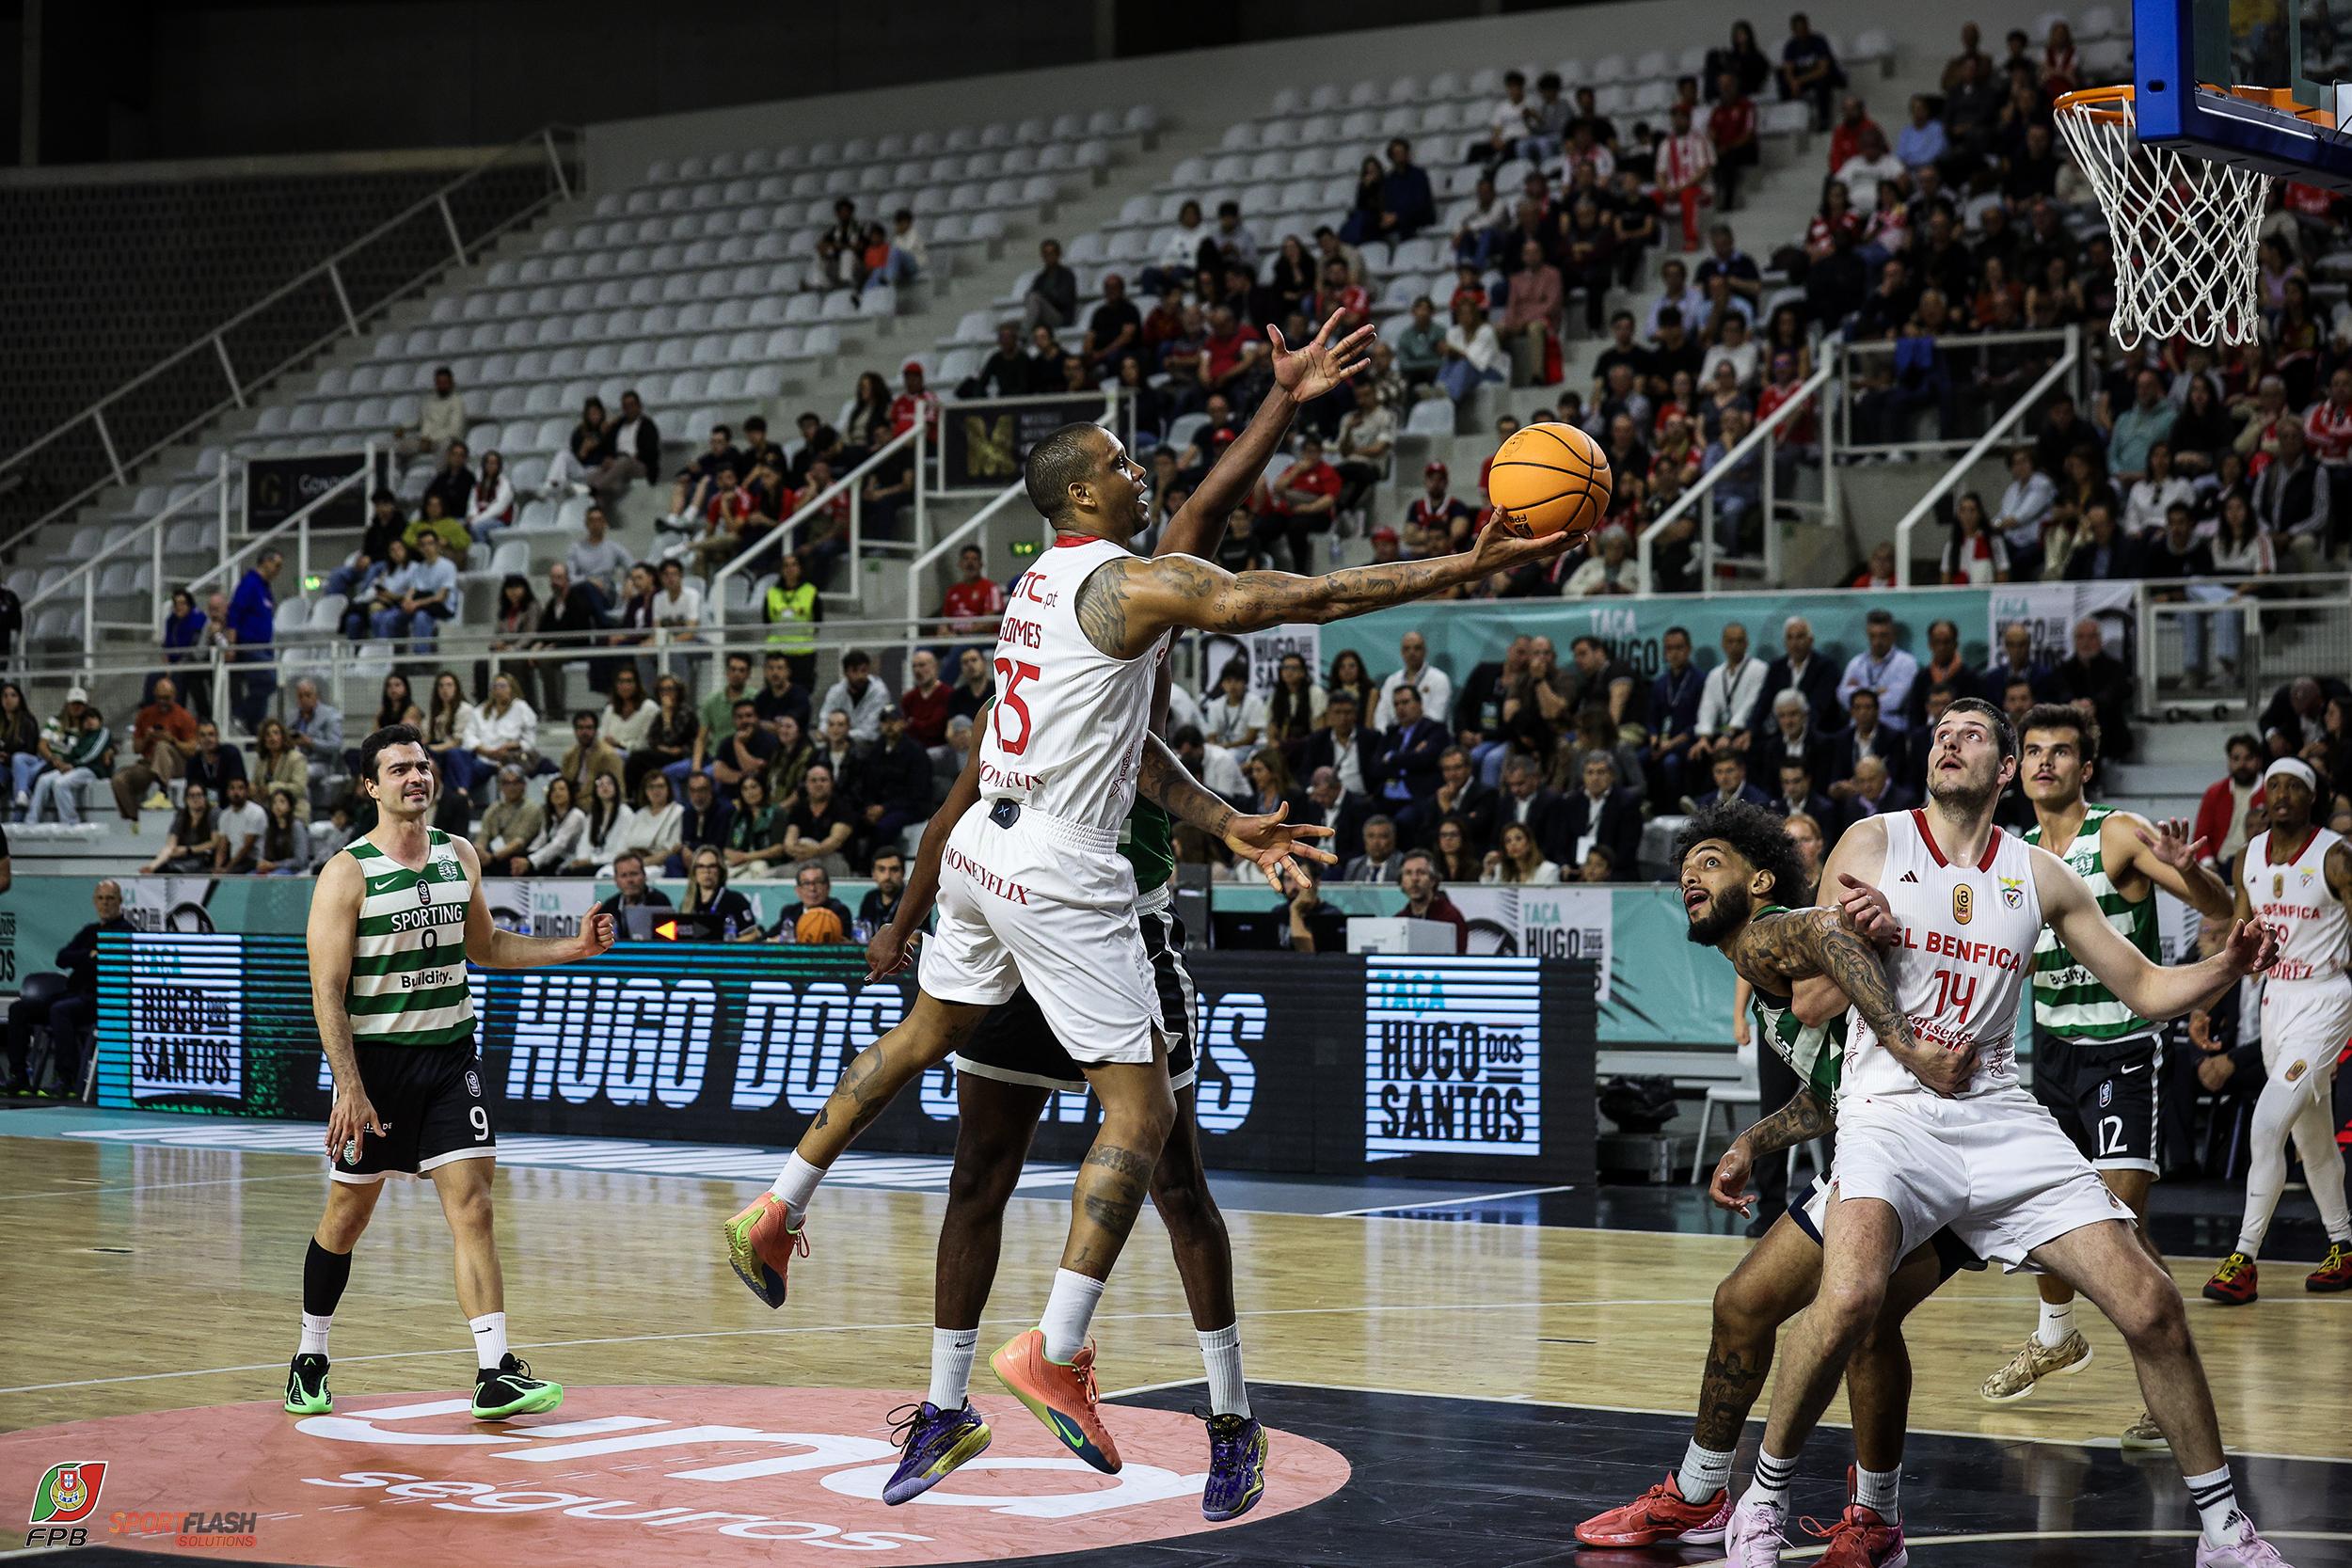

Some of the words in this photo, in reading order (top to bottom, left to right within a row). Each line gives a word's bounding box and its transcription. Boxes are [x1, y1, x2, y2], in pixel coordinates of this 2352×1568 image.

[942, 844, 1032, 906] MONEYFLIX
[391, 905, 463, 931] SPORTING
[1523, 903, 1562, 927] TAÇA
[1526, 927, 1581, 958] HUGO
[1925, 931, 2021, 974] BENFICA
[401, 970, 453, 989] Buildity.
[1376, 973, 1446, 1018] TAÇA
[1934, 970, 1977, 1024] 14
[142, 1037, 230, 1085] SANTOS
[505, 974, 717, 1109] HUGO
[1382, 1022, 1479, 1082] HUGO
[1486, 1034, 1523, 1063] DOS
[469, 1106, 489, 1141] 9
[1380, 1084, 1524, 1142] SANTOS
[2098, 1115, 2128, 1157] 12
[301, 1471, 936, 1551] seguros
